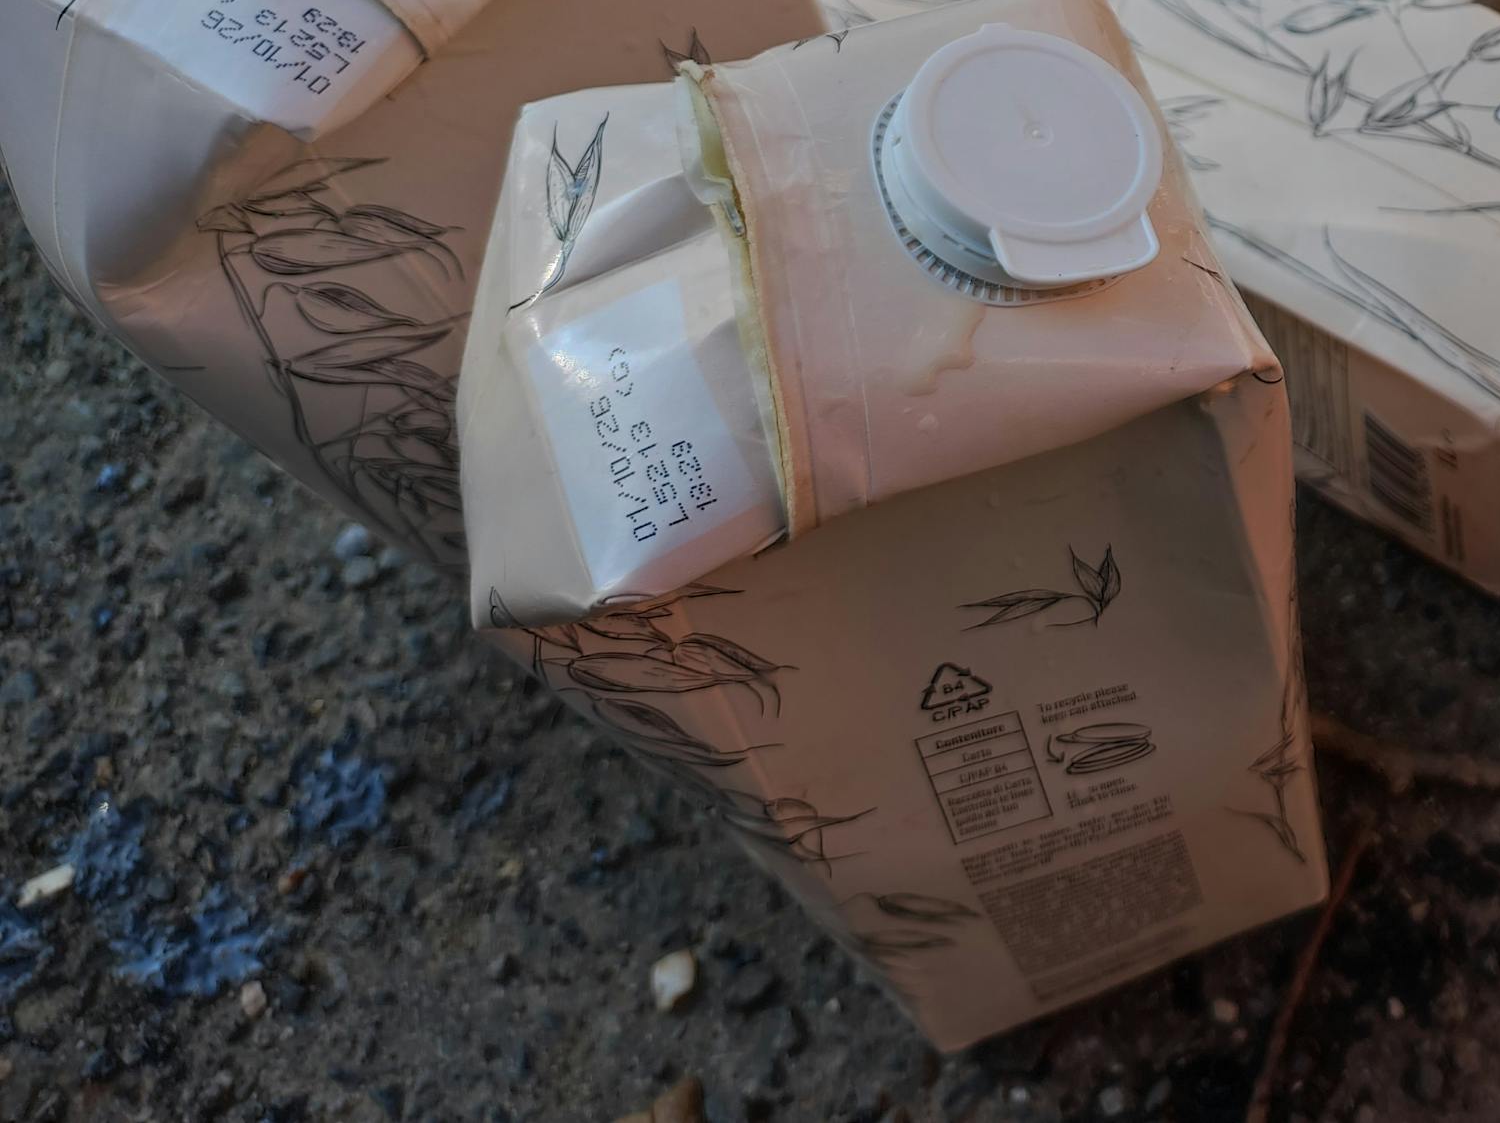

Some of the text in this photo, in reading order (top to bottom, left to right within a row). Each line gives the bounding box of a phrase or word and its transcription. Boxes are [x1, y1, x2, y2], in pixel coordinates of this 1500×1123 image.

[201, 10, 331, 95] 01/10/26
[590, 395, 658, 542] 01/10/26
[630, 421, 689, 526] L5213
[932, 698, 990, 722] C/PAP
